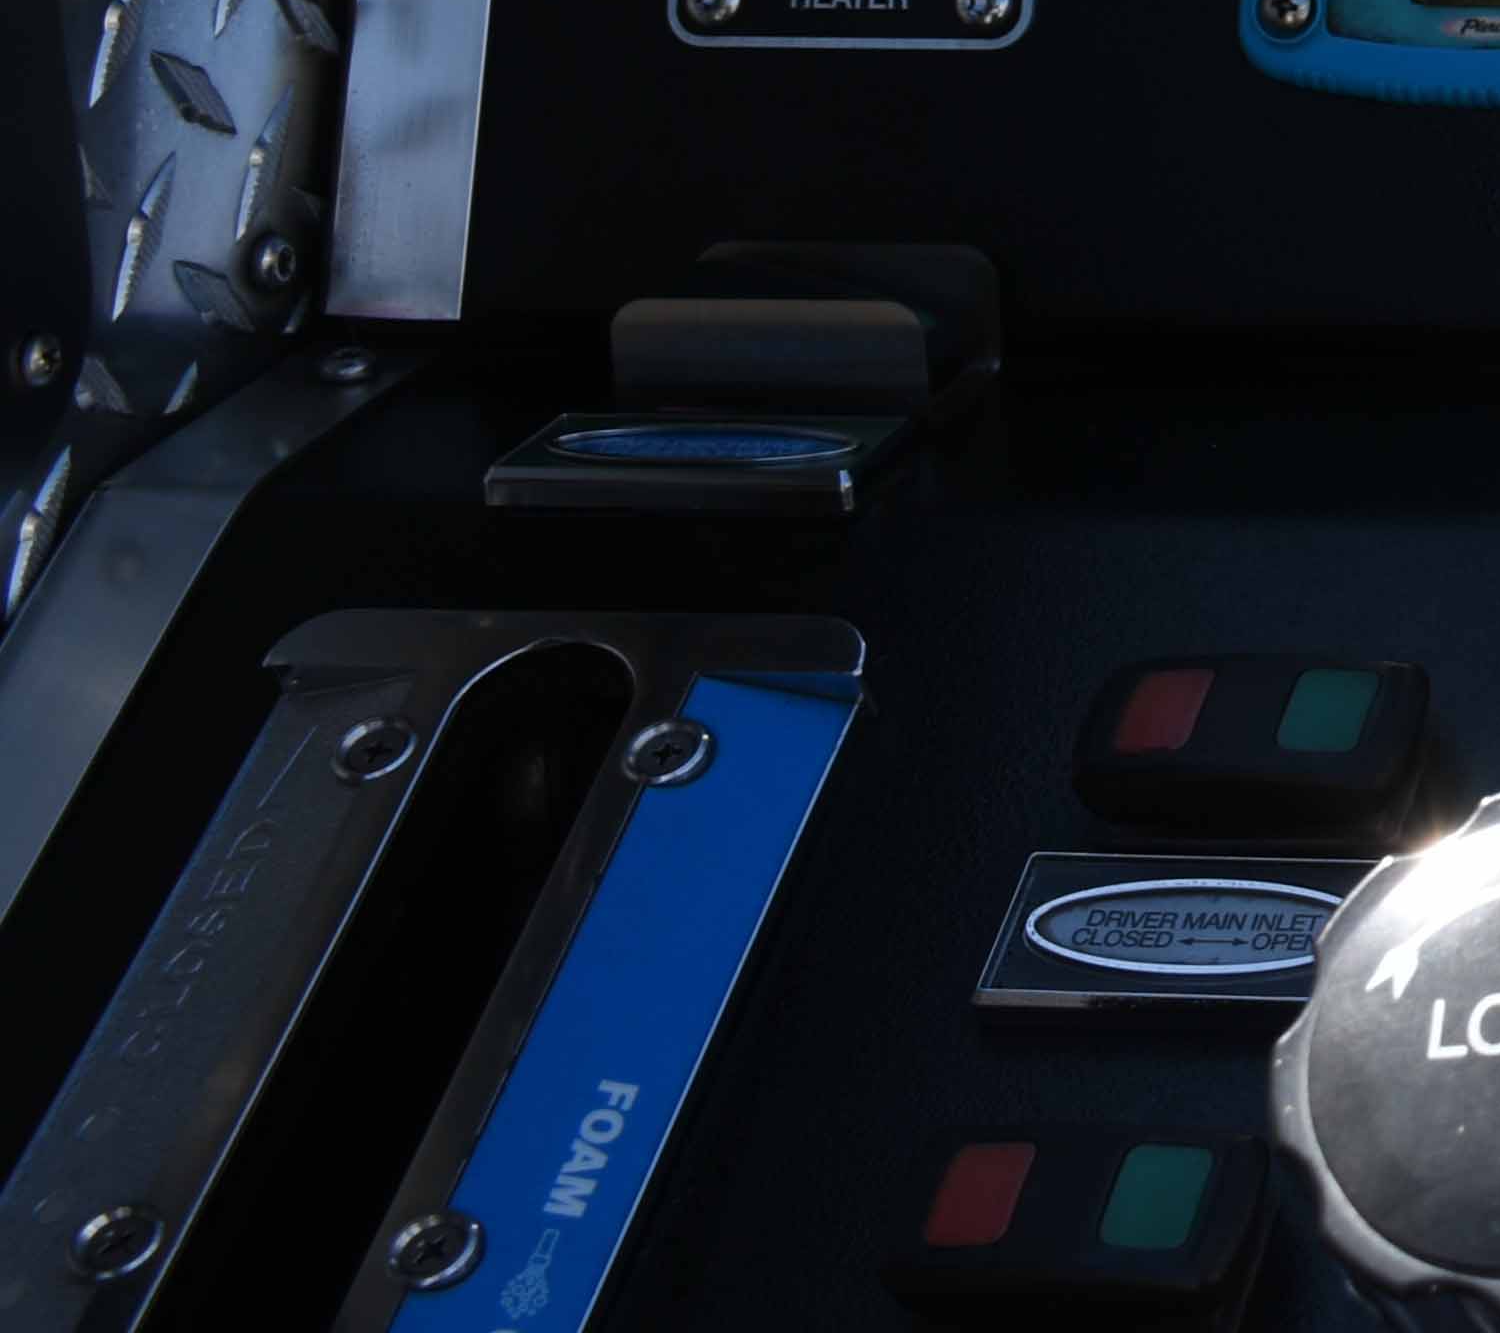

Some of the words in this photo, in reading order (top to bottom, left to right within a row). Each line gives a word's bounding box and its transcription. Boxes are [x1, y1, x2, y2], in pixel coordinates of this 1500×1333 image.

[1086, 909, 1179, 930] DRIVER
[1183, 912, 1249, 932] MAIN
[1252, 914, 1323, 933] INLET
[1071, 928, 1174, 948] CLOSED
[543, 1078, 639, 1217] FOAM
